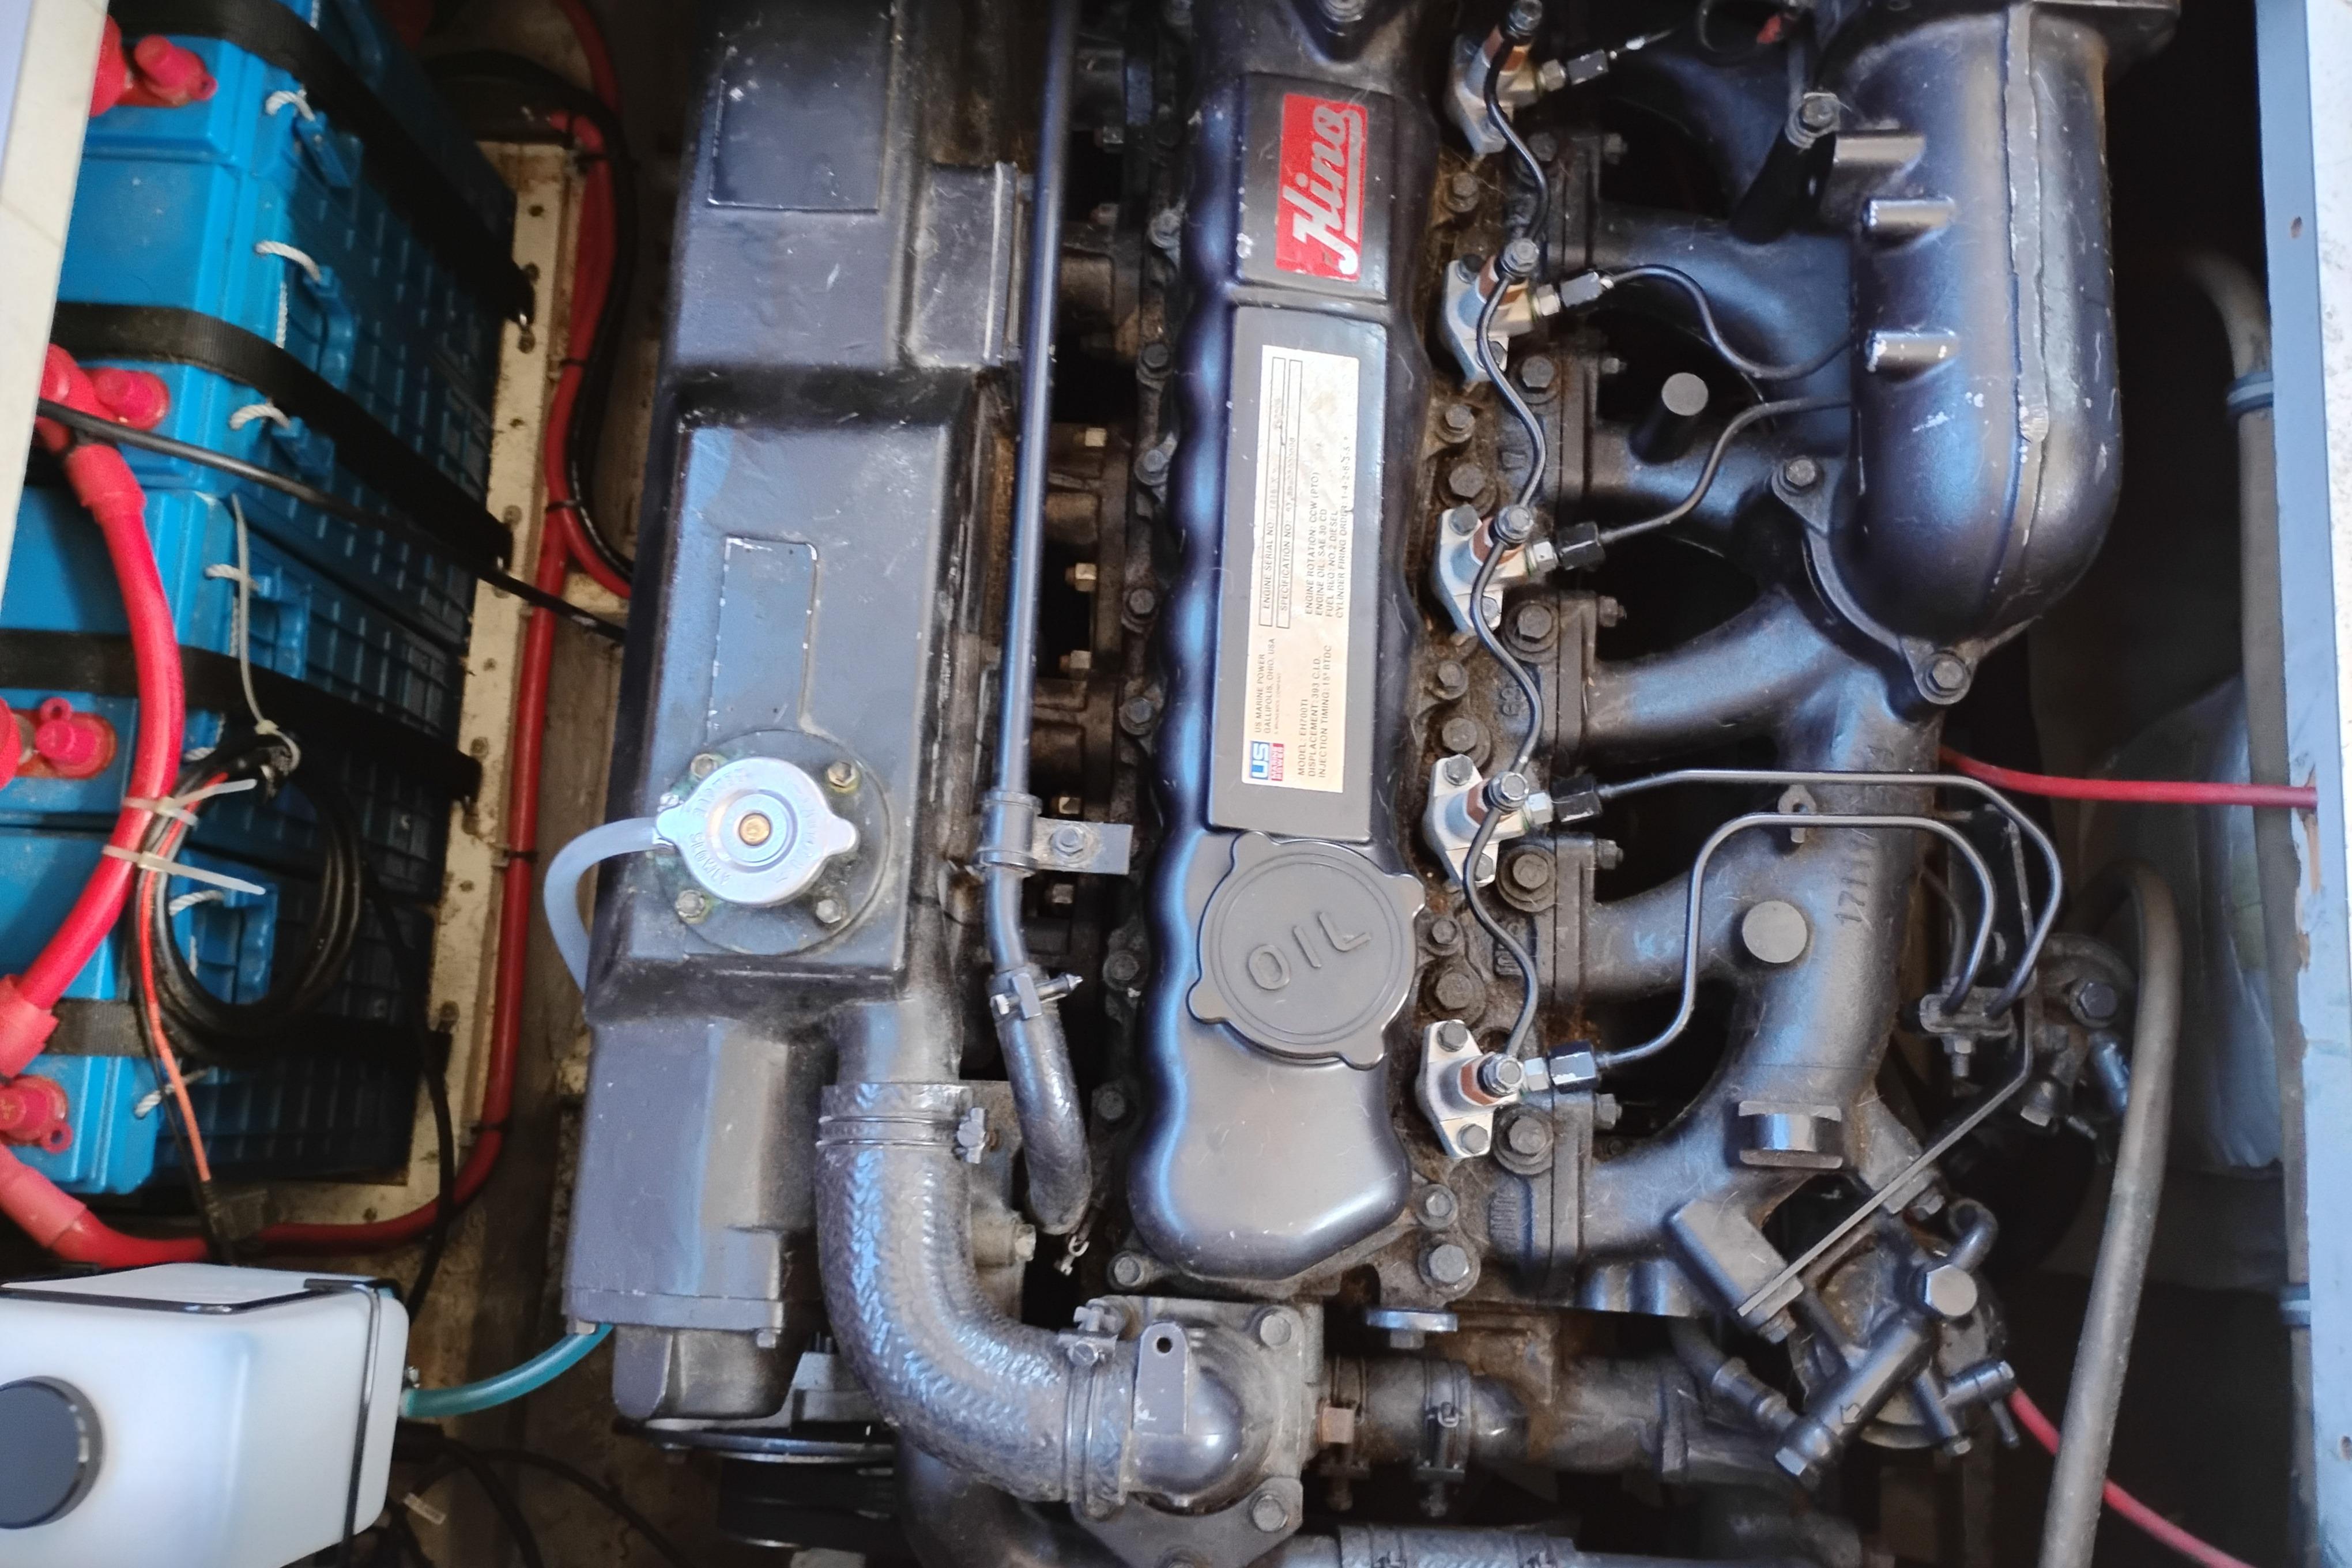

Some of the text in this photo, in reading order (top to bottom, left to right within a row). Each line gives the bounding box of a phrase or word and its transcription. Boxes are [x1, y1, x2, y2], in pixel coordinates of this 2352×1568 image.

[1283, 105, 1362, 274] Hino
[1283, 520, 1291, 537] NO:
[1318, 525, 1326, 535] 30
[1319, 508, 1326, 521] CD
[1329, 510, 1337, 541] DIESEL
[1264, 540, 1273, 571] SERIAL
[1305, 472, 1319, 614] ENGINE ROTATION: CCW (PTO)
[1317, 538, 1326, 556] SAE
[1328, 544, 1336, 566] NO.2
[1337, 539, 1346, 570] FIRING
[1262, 575, 1271, 609] ENGINE
[1280, 541, 1290, 611] SPECIFICATION
[1315, 581, 1324, 616] ENGINE
[1325, 595, 1334, 617] FUEL
[1335, 572, 1345, 618] CYLINDER
[1323, 645, 1331, 670] BTDC
[1254, 654, 1265, 732] US MARINE POWER
[1264, 683, 1273, 733] GALLIPOLIS,
[1321, 688, 1329, 723] TIMING:
[1307, 656, 1320, 777] DISPLACEMENT: 393 C.I.D.
[1252, 742, 1269, 778] US
[1297, 738, 1306, 775] MODEL:
[1318, 728, 1328, 778] INJECTION
[1248, 911, 1371, 990] OIL
